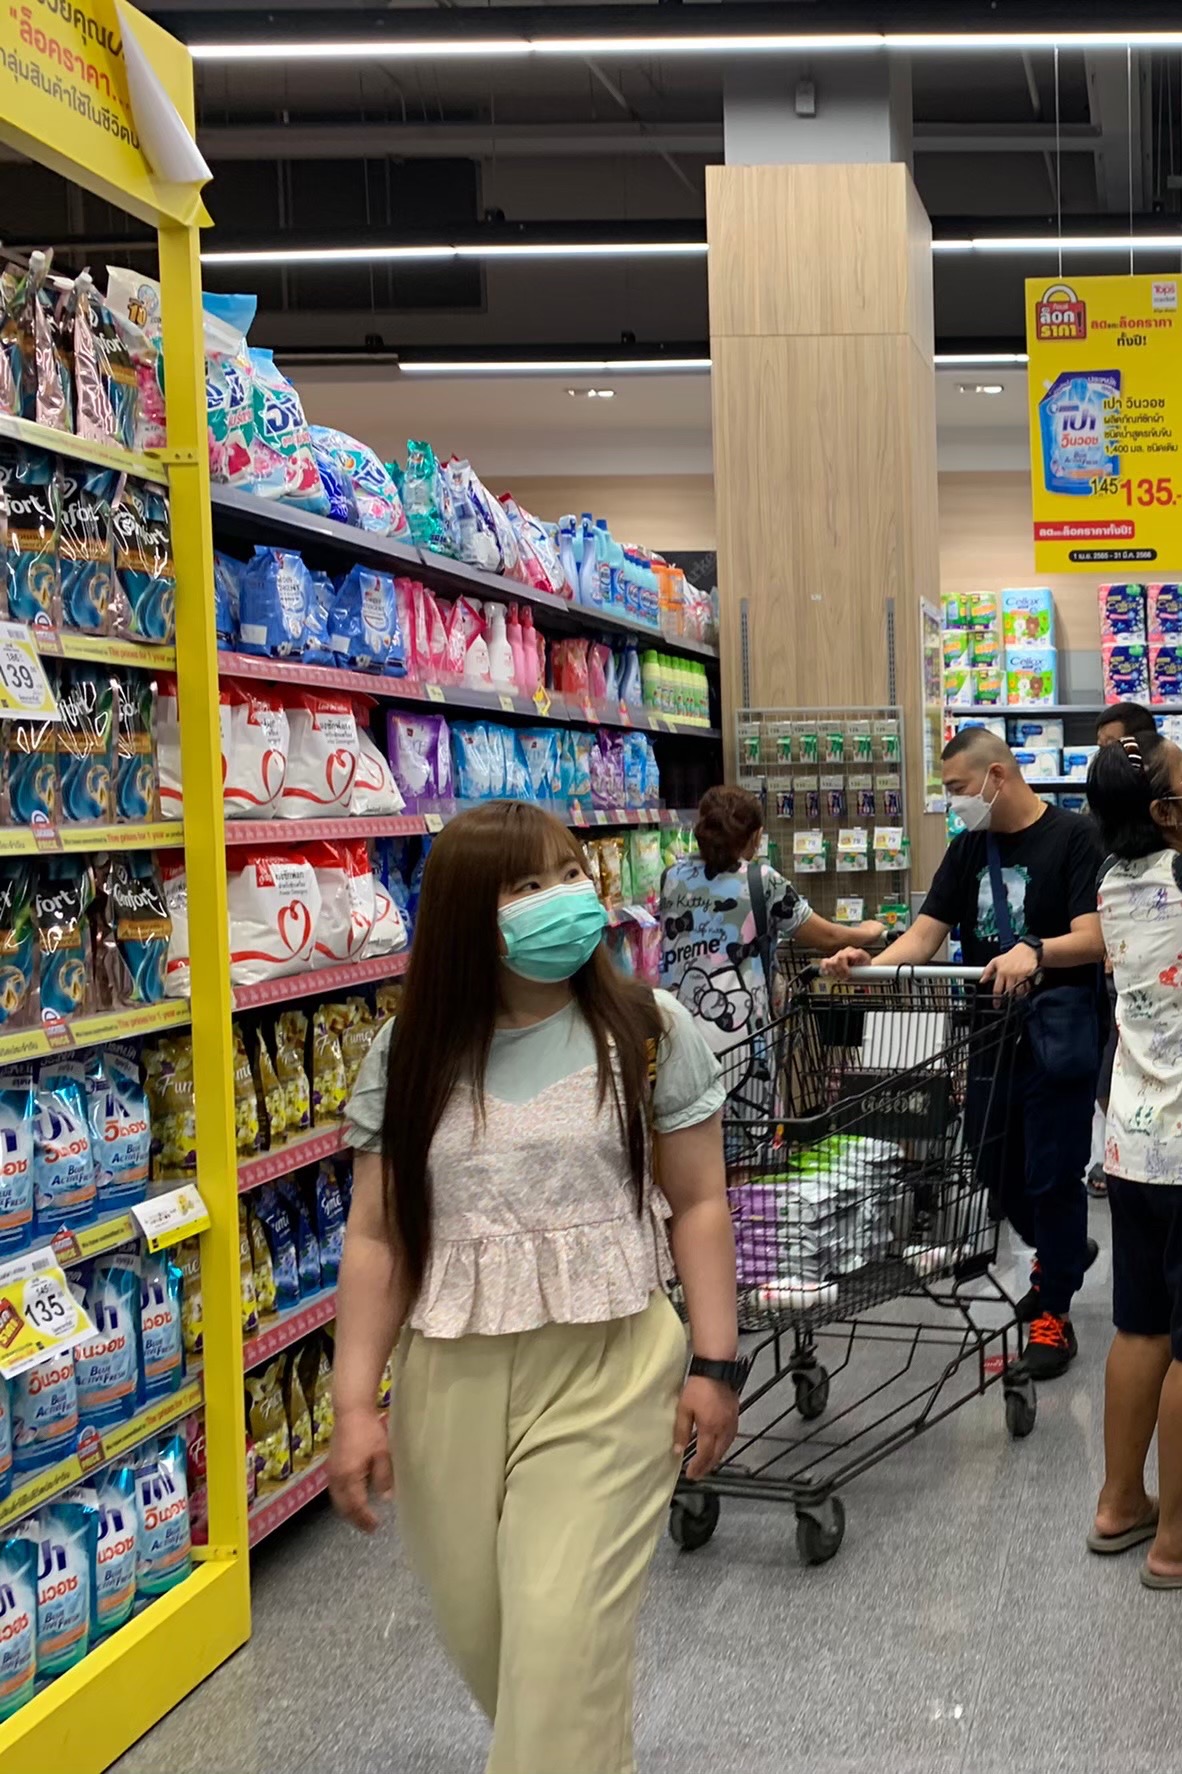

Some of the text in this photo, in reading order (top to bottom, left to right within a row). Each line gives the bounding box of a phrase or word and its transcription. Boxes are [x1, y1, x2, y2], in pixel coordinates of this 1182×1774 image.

[1105, 445, 1128, 455] 1,400
[1090, 478, 1118, 496] 145
[25, 1294, 65, 1327] 135
